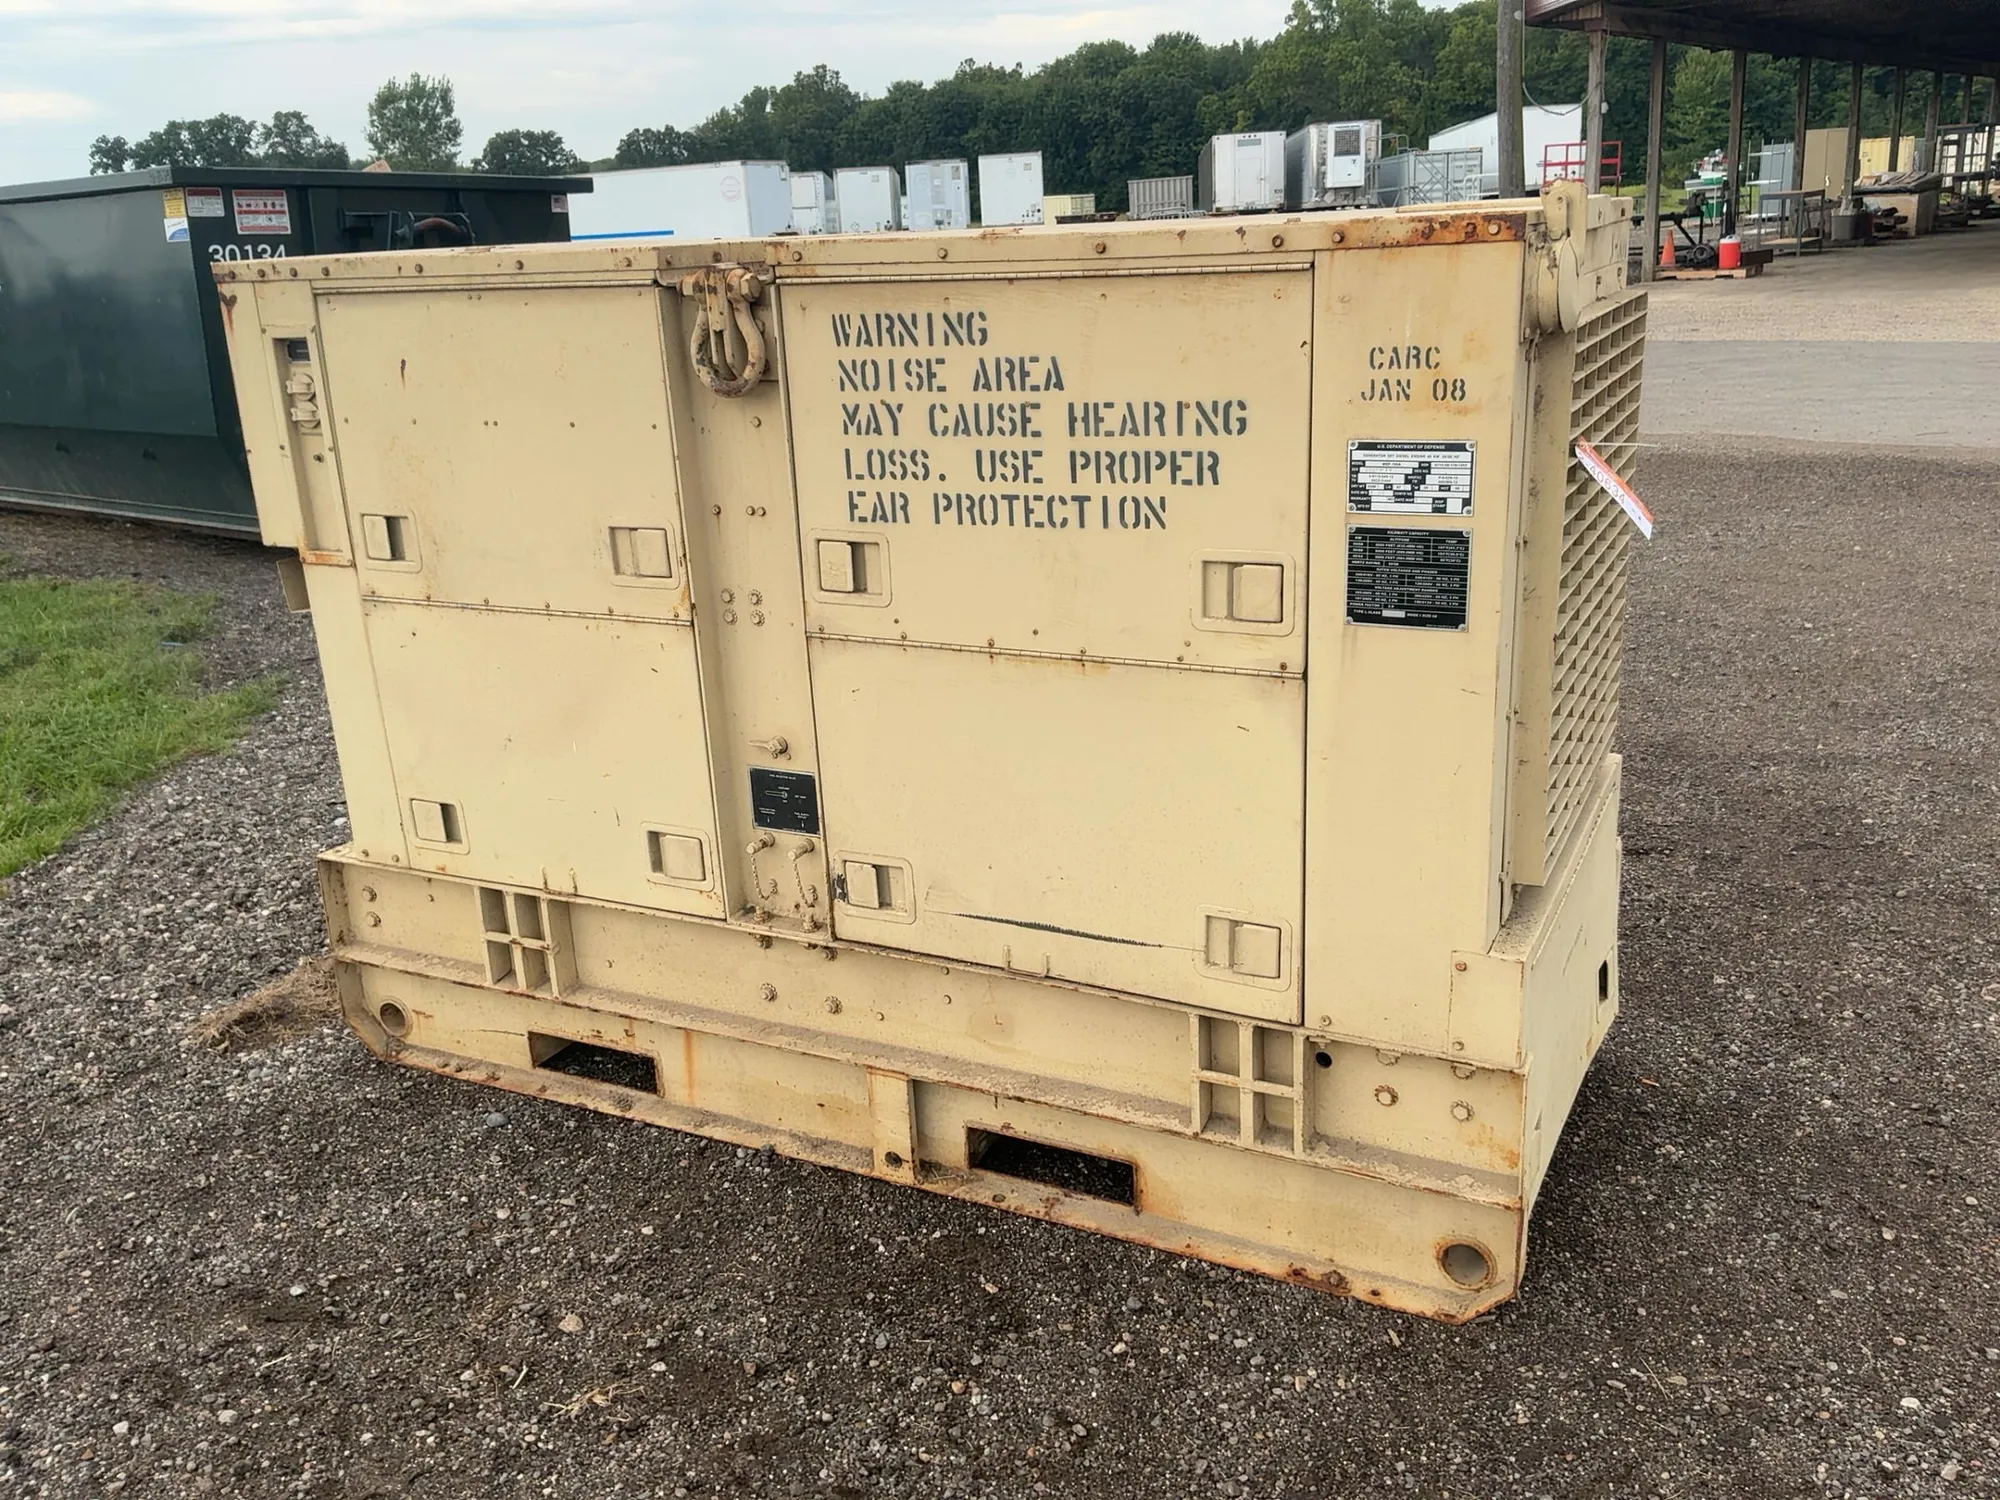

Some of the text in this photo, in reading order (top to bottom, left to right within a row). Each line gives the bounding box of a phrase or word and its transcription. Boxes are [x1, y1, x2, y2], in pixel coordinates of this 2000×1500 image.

[832, 312, 988, 346] WARNING
[838, 356, 1064, 392] NOISE AREA
[1369, 346, 1440, 370] CARC
[1360, 378, 1466, 402] JAN 08
[842, 400, 1248, 437] MAY CAUSE HEARING
[844, 448, 1220, 486] LOSS. USE PROPER
[848, 491, 1166, 530] EAR PROTECTION
